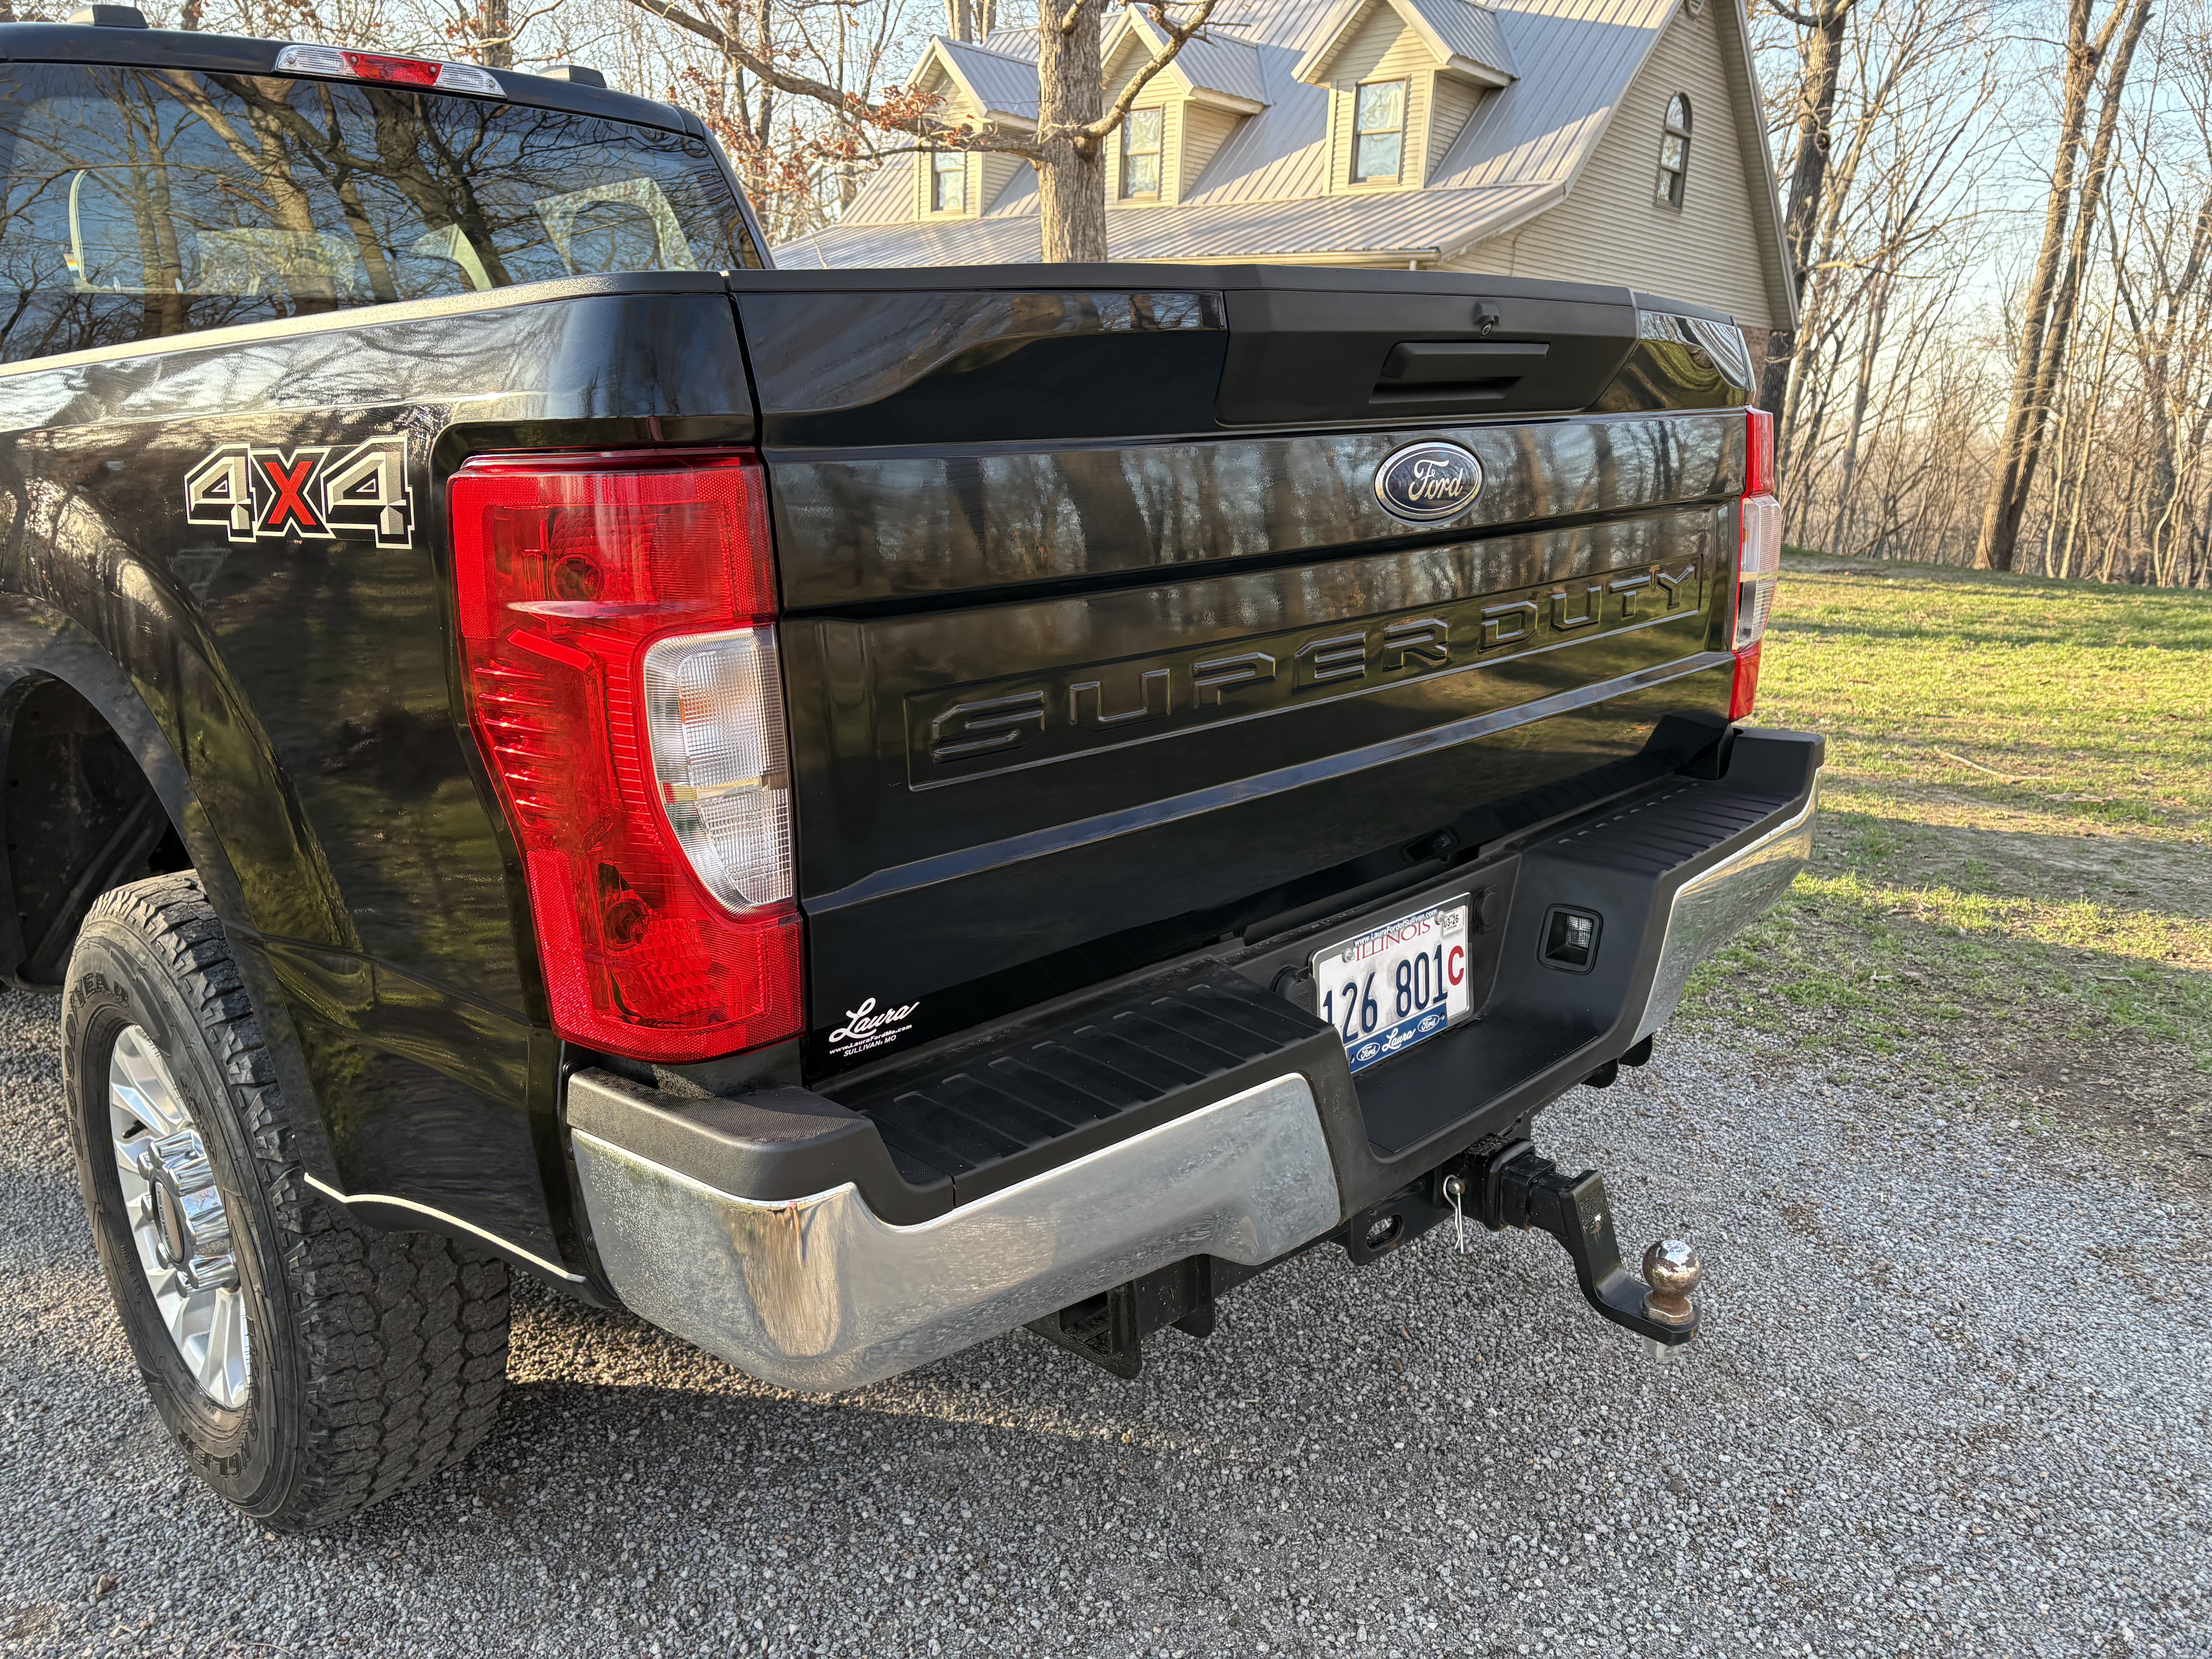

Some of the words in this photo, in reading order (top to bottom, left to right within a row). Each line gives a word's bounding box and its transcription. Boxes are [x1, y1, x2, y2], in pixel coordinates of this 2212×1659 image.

[1408, 459, 1463, 502] Ford
[931, 618, 1451, 764] SUPER
[1478, 558, 1697, 654] DUTY
[1354, 908, 1437, 946] www.LauraFordofSullivan.com
[1356, 920, 1431, 962] ILLINOIS
[829, 997, 920, 1042] Laura
[1322, 971, 1377, 1044] 126
[829, 1024, 912, 1054] www.LauraFordMo.com
[884, 1034, 897, 1044] MO
[1360, 1046, 1377, 1060] Ford
[1381, 1027, 1416, 1052] Laura
[1421, 1017, 1437, 1032] Ford
